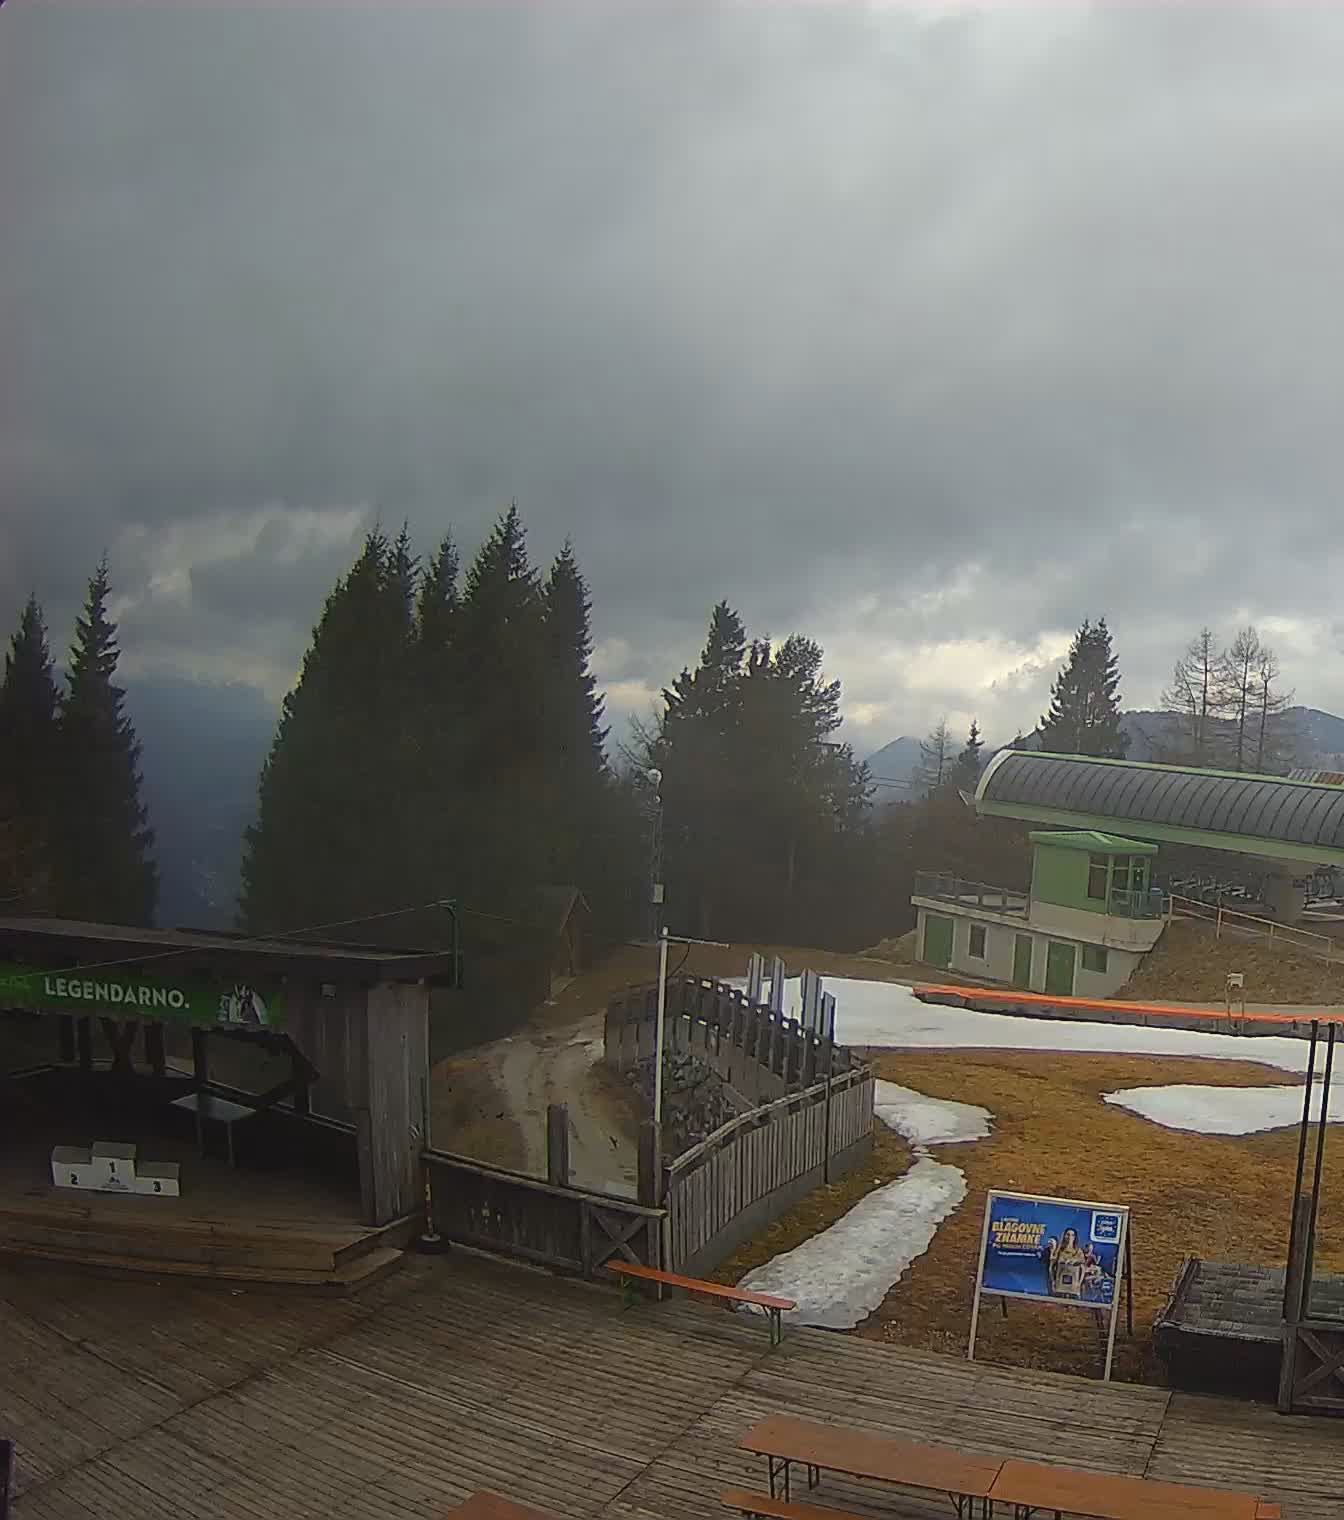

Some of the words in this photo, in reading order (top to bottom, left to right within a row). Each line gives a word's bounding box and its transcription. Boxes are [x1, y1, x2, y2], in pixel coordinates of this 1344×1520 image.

[44, 976, 190, 1009] LEGENDARNO.
[109, 1161, 116, 1174] 1
[70, 1172, 79, 1185] 2
[152, 1180, 162, 1193] 3
[992, 1221, 1046, 1234] BLAGOVNE
[994, 1232, 1041, 1244] ZNAMKE
